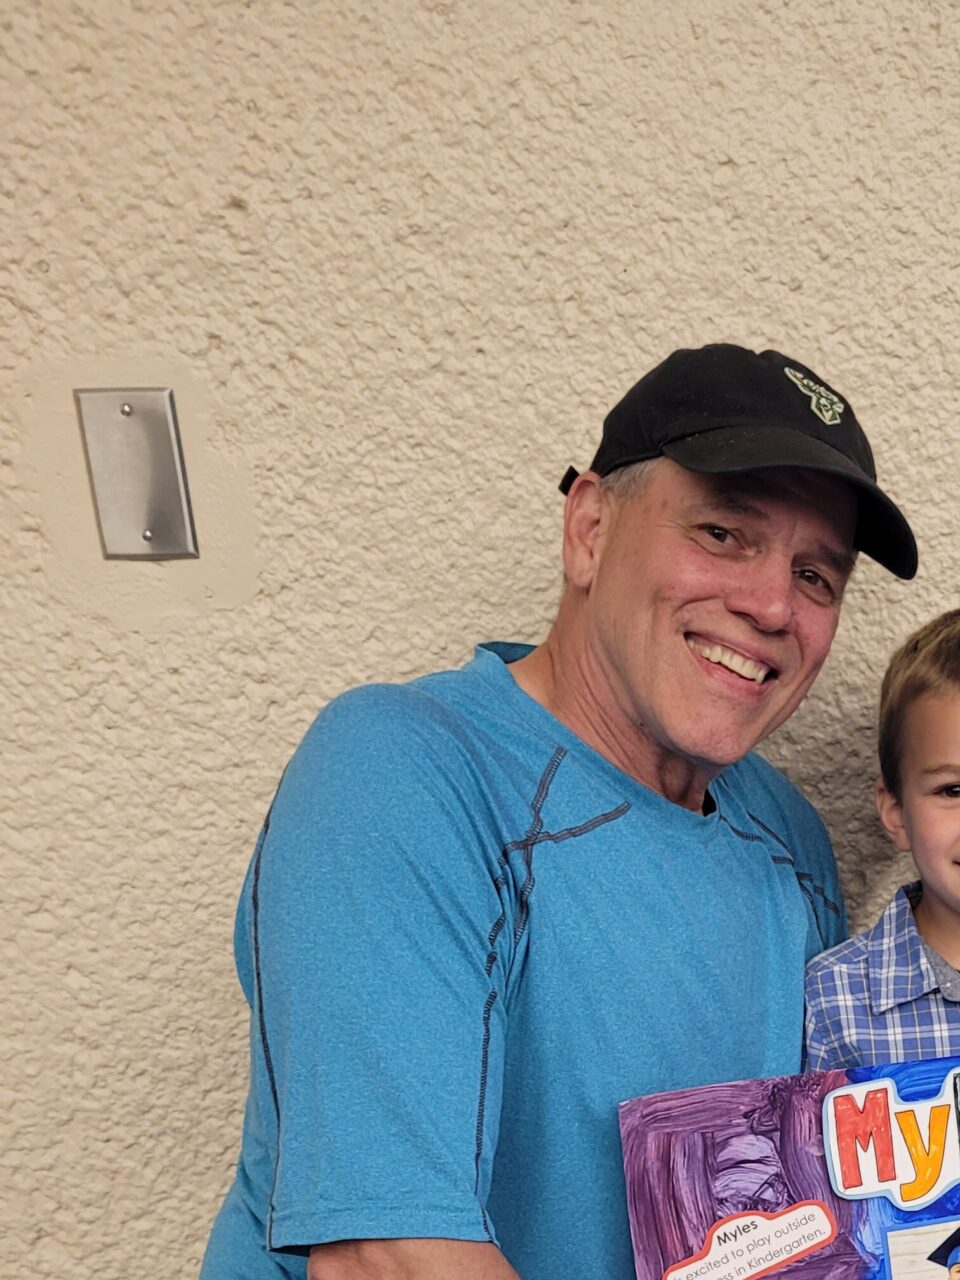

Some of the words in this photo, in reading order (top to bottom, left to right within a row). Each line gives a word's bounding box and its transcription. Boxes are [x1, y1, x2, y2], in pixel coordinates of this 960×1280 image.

[716, 1219, 758, 1247] Myles
[731, 1248, 745, 1260] to
[746, 1233, 772, 1255] play
[774, 1212, 817, 1239] outside
[735, 1264, 747, 1278] in
[749, 1227, 827, 1271] Kindergarten.
